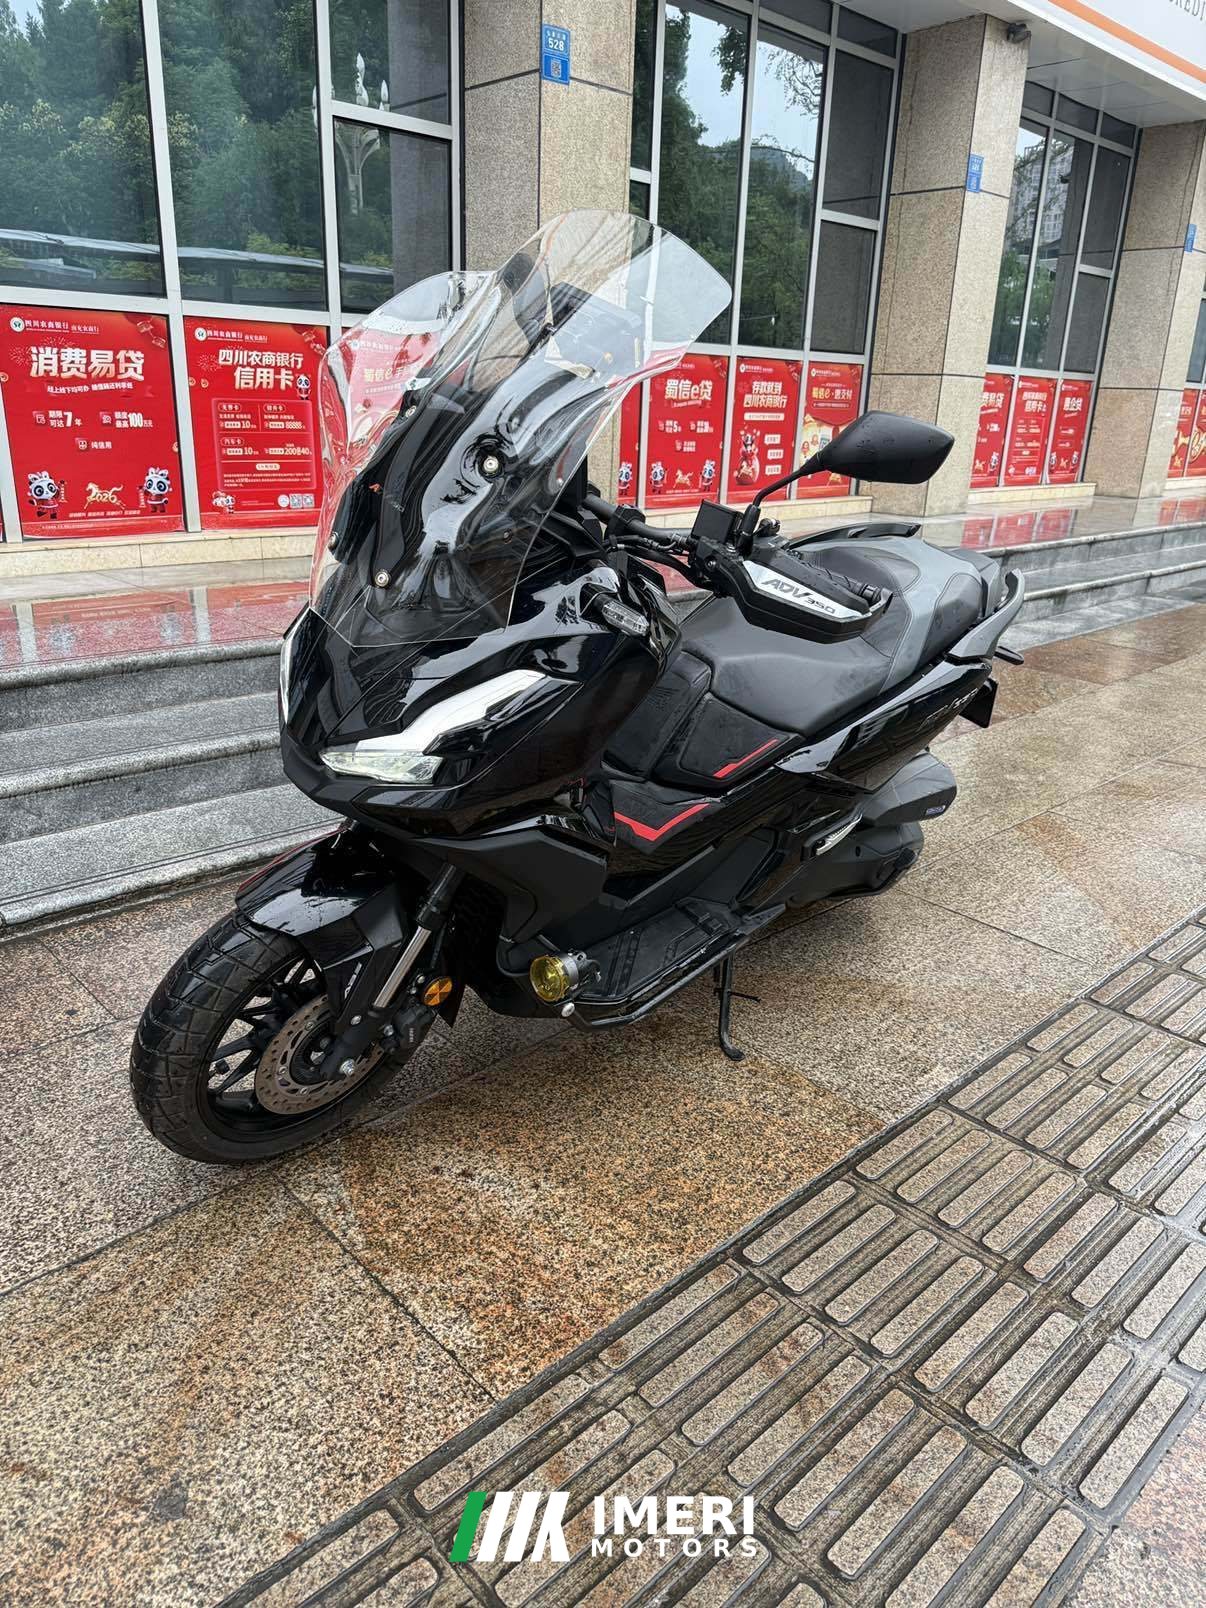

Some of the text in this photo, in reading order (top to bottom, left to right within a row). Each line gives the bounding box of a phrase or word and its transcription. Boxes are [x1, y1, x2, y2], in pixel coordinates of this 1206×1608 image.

[548, 37, 564, 51] 528
[30, 346, 144, 381] 消费易贷
[218, 349, 304, 369] 四川农商银行
[234, 367, 294, 391] 信用卡
[664, 379, 713, 401] 蜀信e贷
[90, 492, 117, 503] 2026
[761, 578, 836, 614] ADV 350
